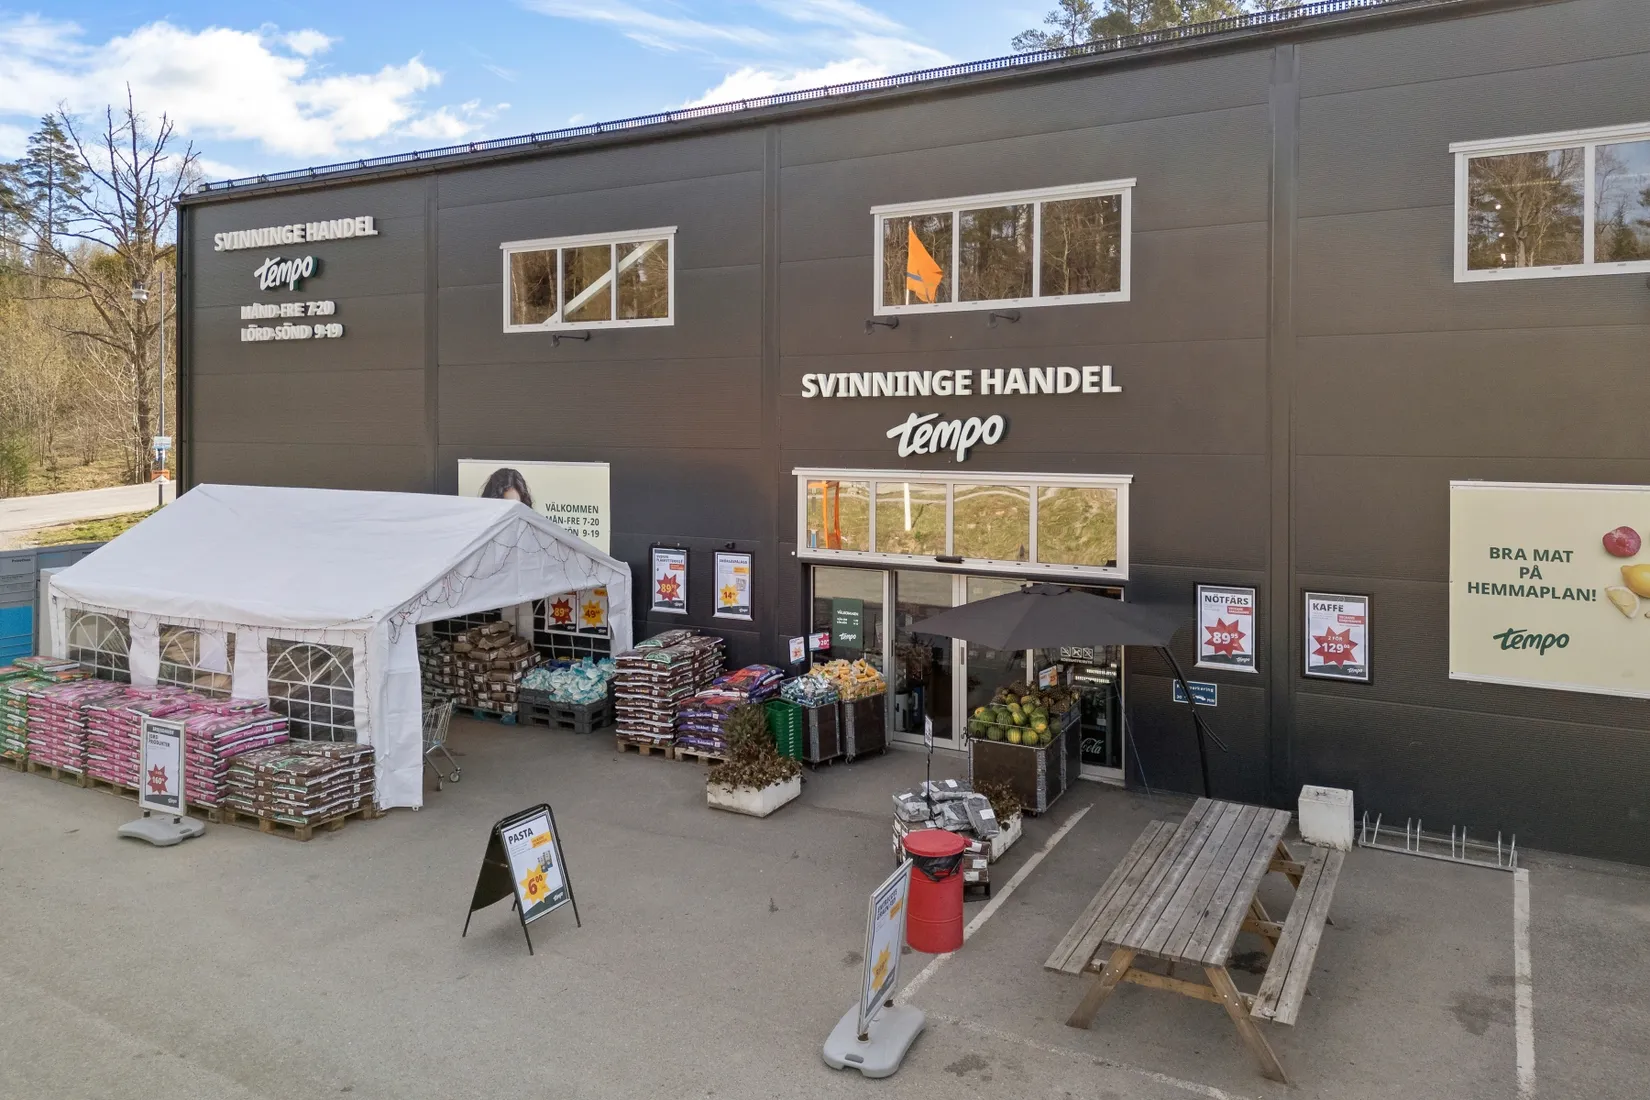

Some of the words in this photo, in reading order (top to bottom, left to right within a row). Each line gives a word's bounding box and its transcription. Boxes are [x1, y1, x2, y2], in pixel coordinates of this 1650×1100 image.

[214, 224, 305, 251] SVINNINGE
[306, 216, 378, 241] HANDEL
[254, 256, 318, 291] tempo
[306, 300, 335, 316] 7-20
[314, 323, 343, 339] 9-19
[801, 369, 973, 397] SVINNINGE
[980, 365, 1122, 395] HANDEL
[886, 412, 1005, 462] tempo
[545, 501, 599, 514] VÄLKOMMEN
[582, 517, 600, 526] 7-20
[565, 526, 579, 537] ÖN
[582, 529, 600, 538] 9-19
[1489, 546, 1527, 561] BRA
[1533, 549, 1574, 563] MAT
[1519, 565, 1543, 580] PÅ
[1467, 581, 1597, 602] HEMMAPLAN!
[1204, 594, 1249, 606] NÖTFÄRS
[1312, 602, 1344, 613] KAFFE
[1492, 628, 1570, 656] tempo
[508, 827, 533, 844] PASTA
